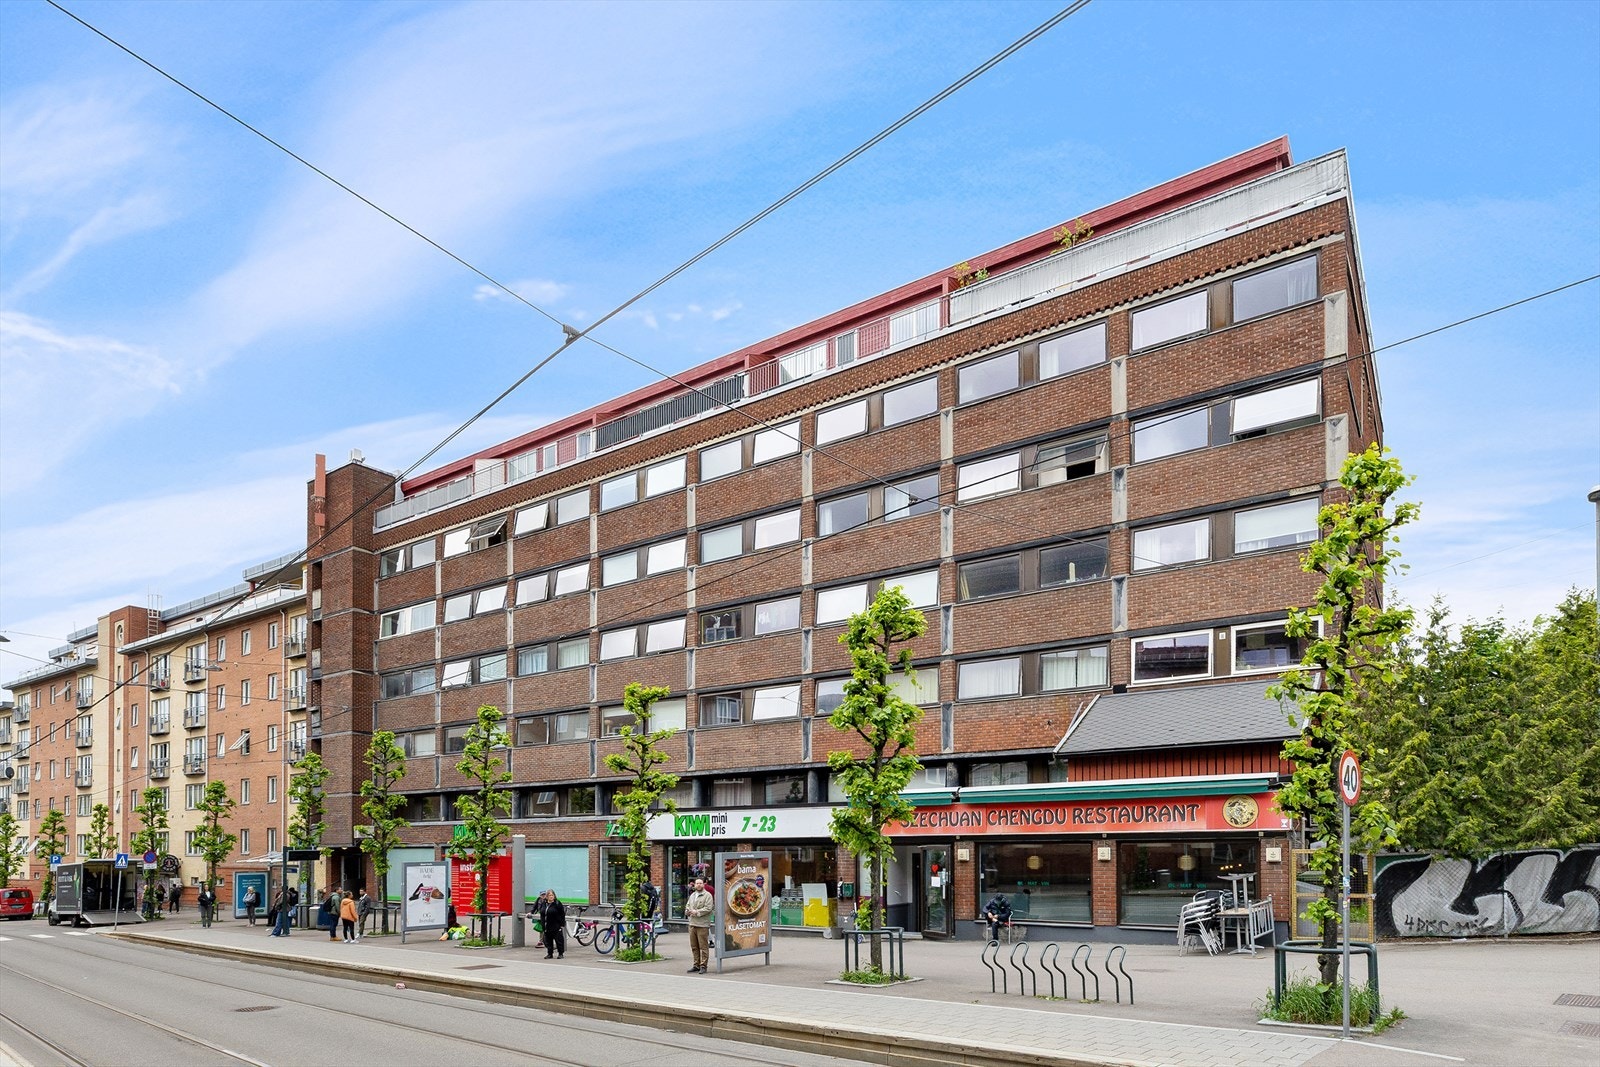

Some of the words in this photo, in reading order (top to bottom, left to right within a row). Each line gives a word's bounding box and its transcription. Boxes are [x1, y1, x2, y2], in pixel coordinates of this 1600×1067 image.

[1343, 764, 1358, 792] 40
[674, 814, 711, 837] KIWI
[711, 812, 728, 824] mini
[987, 807, 1068, 826] CHENGDU
[1072, 803, 1201, 825] RESTAURANT
[711, 825, 726, 837] pris
